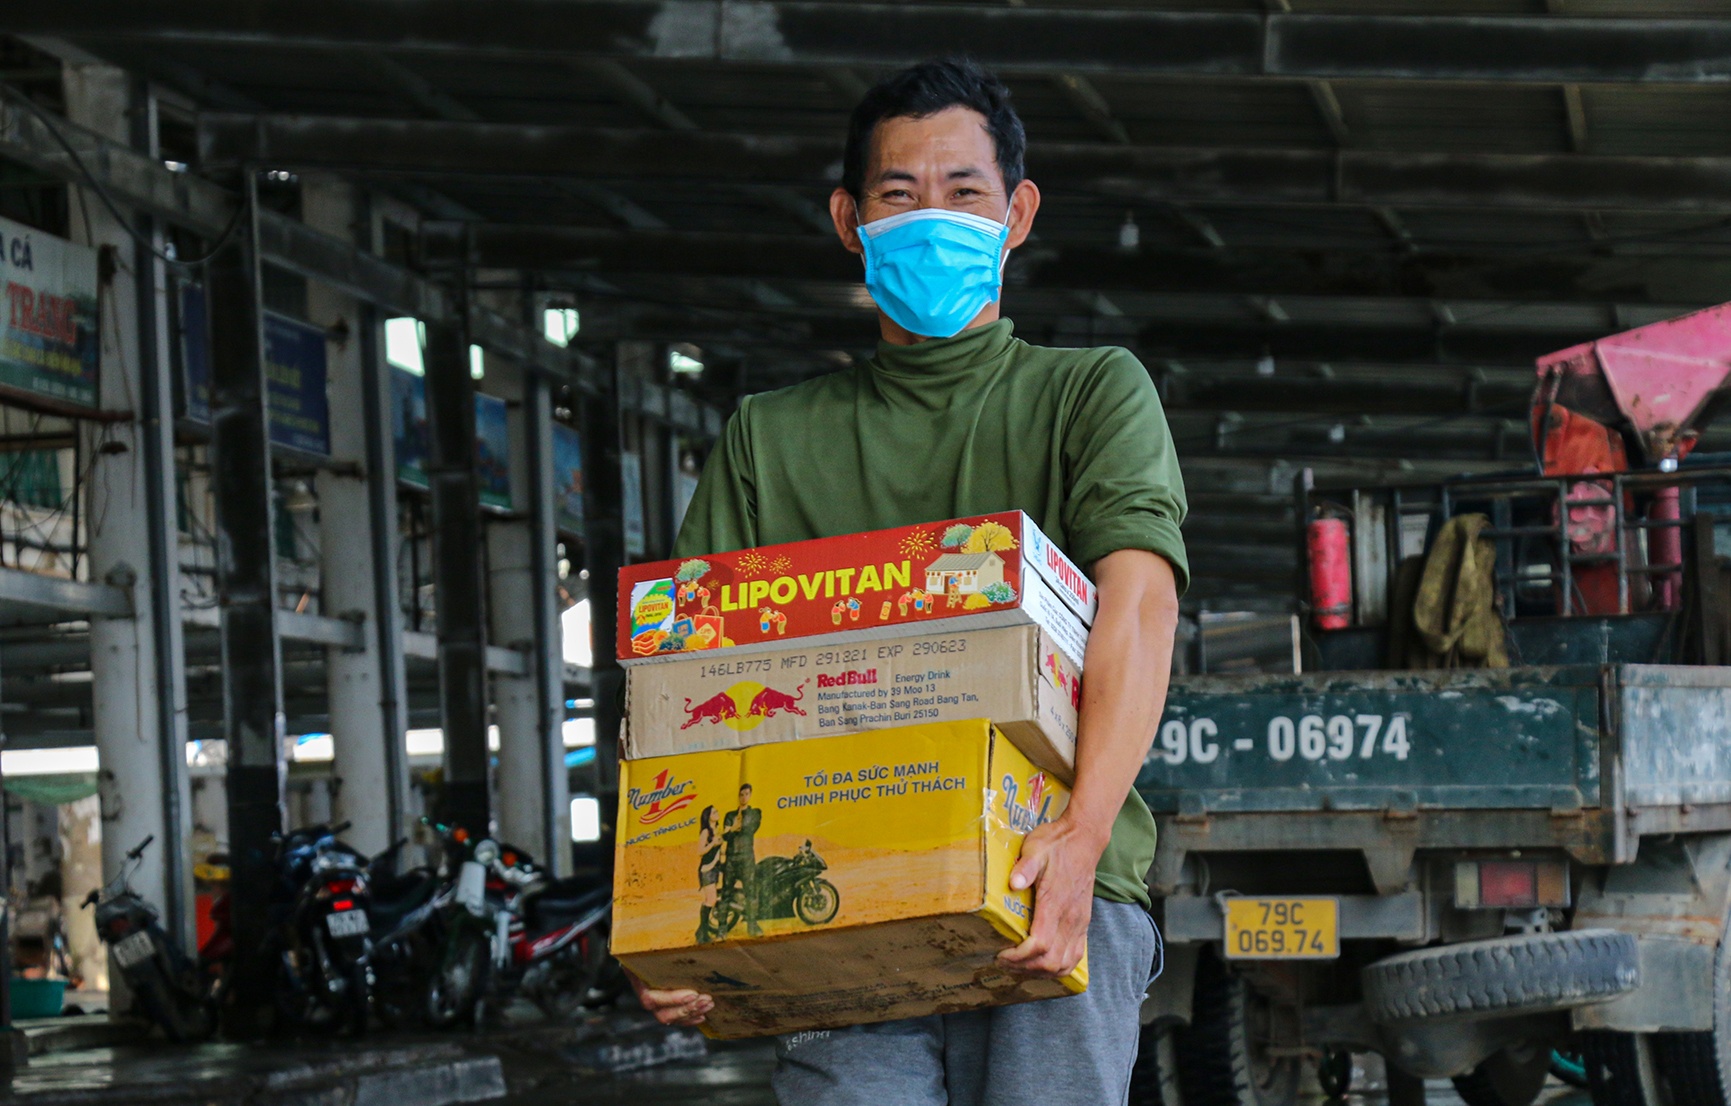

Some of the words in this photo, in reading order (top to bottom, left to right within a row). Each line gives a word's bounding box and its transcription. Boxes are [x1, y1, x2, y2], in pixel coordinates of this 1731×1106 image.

[11, 234, 33, 271] CÁ
[721, 560, 911, 613] LIPOVITAN
[1046, 543, 1088, 606] LIPOVITAN
[700, 658, 772, 678] 146LB775
[780, 655, 808, 669] MFD
[815, 649, 867, 666] 291221
[877, 644, 904, 659] EXP
[912, 639, 967, 656] 290623
[817, 688, 876, 700] Manufactured
[877, 687, 889, 698] by
[891, 687, 902, 696] 39
[904, 686, 923, 695] Moo
[926, 683, 936, 692] 13
[895, 674, 926, 683] Energy
[927, 670, 951, 680] Drink
[818, 704, 840, 715] Bang
[889, 699, 911, 709] Sang
[913, 696, 935, 706] Road
[937, 695, 959, 705] Bang
[819, 717, 836, 728] Ban
[838, 715, 858, 726] Sang
[860, 713, 892, 724] Prachin
[894, 711, 911, 721] Buri
[913, 708, 939, 719] 25150
[1162, 717, 1220, 765] 9C
[1267, 713, 1411, 761] 06974
[804, 770, 828, 788] TỐI
[832, 772, 853, 784] ĐA
[858, 765, 889, 782] SỨC
[894, 761, 940, 779] MẠNH
[627, 776, 693, 810] Number
[777, 793, 824, 809] CHINH
[829, 787, 871, 803] PHỤC
[876, 778, 908, 797] THỬ
[912, 775, 966, 793] THÁCH
[1258, 902, 1305, 926] 79C
[1238, 929, 1325, 953] 069.74
